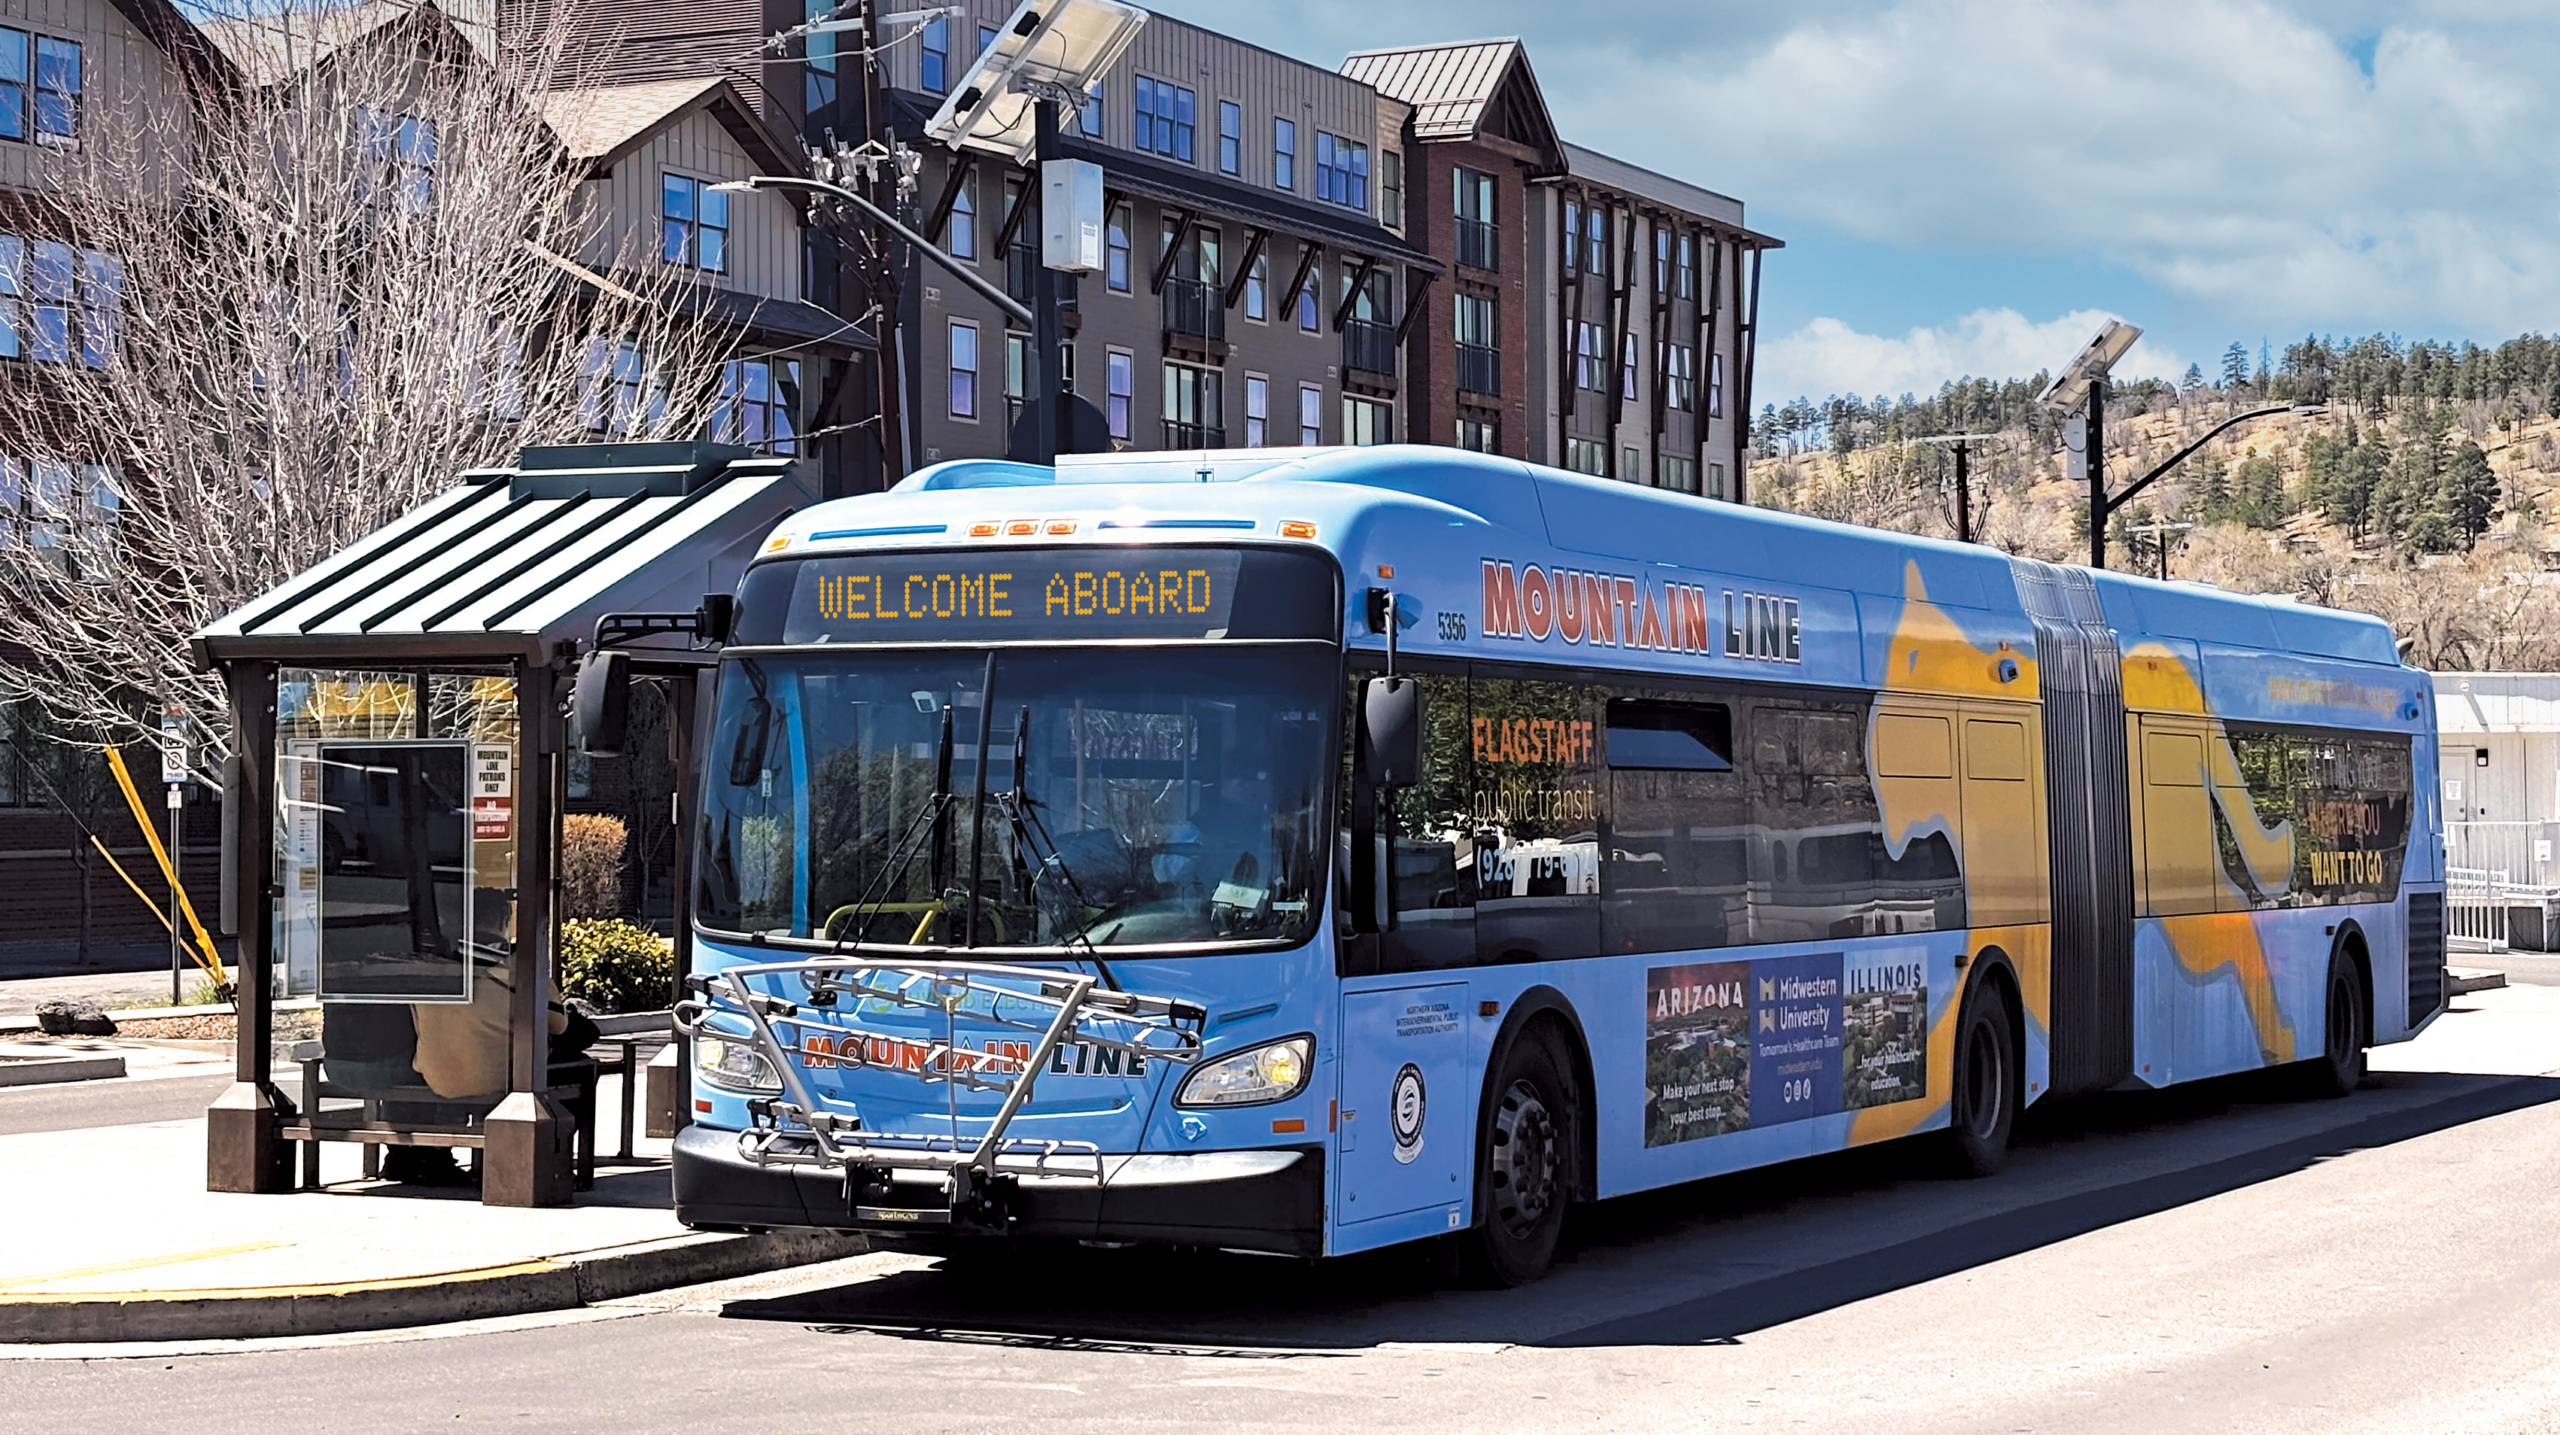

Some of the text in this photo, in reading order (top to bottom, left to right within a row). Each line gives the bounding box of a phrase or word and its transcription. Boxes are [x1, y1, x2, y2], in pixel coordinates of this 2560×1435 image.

[818, 569, 1211, 620] WELCOME ABOARD
[1480, 556, 1802, 666] MOUNTAIN LINE
[1437, 611, 1467, 642] 5356
[1472, 717, 1593, 763] FLAGSTAFF
[1474, 777, 1596, 829] public transit
[2310, 850, 2383, 886] WANT TO GO
[1780, 975, 1837, 1001] Midwestern
[1850, 963, 1922, 995] ILLINOIS
[1656, 981, 1744, 1018] ARIZONA
[1780, 1003, 1831, 1031] University
[801, 1033, 1149, 1079] MOUNTAIN LINE
[1759, 1034, 1840, 1057] Tomorrow's Healthcare Team
[1662, 1077, 1735, 1102] Make your next stop
[1669, 1111, 1687, 1130] your
[1688, 1107, 1705, 1123] best
